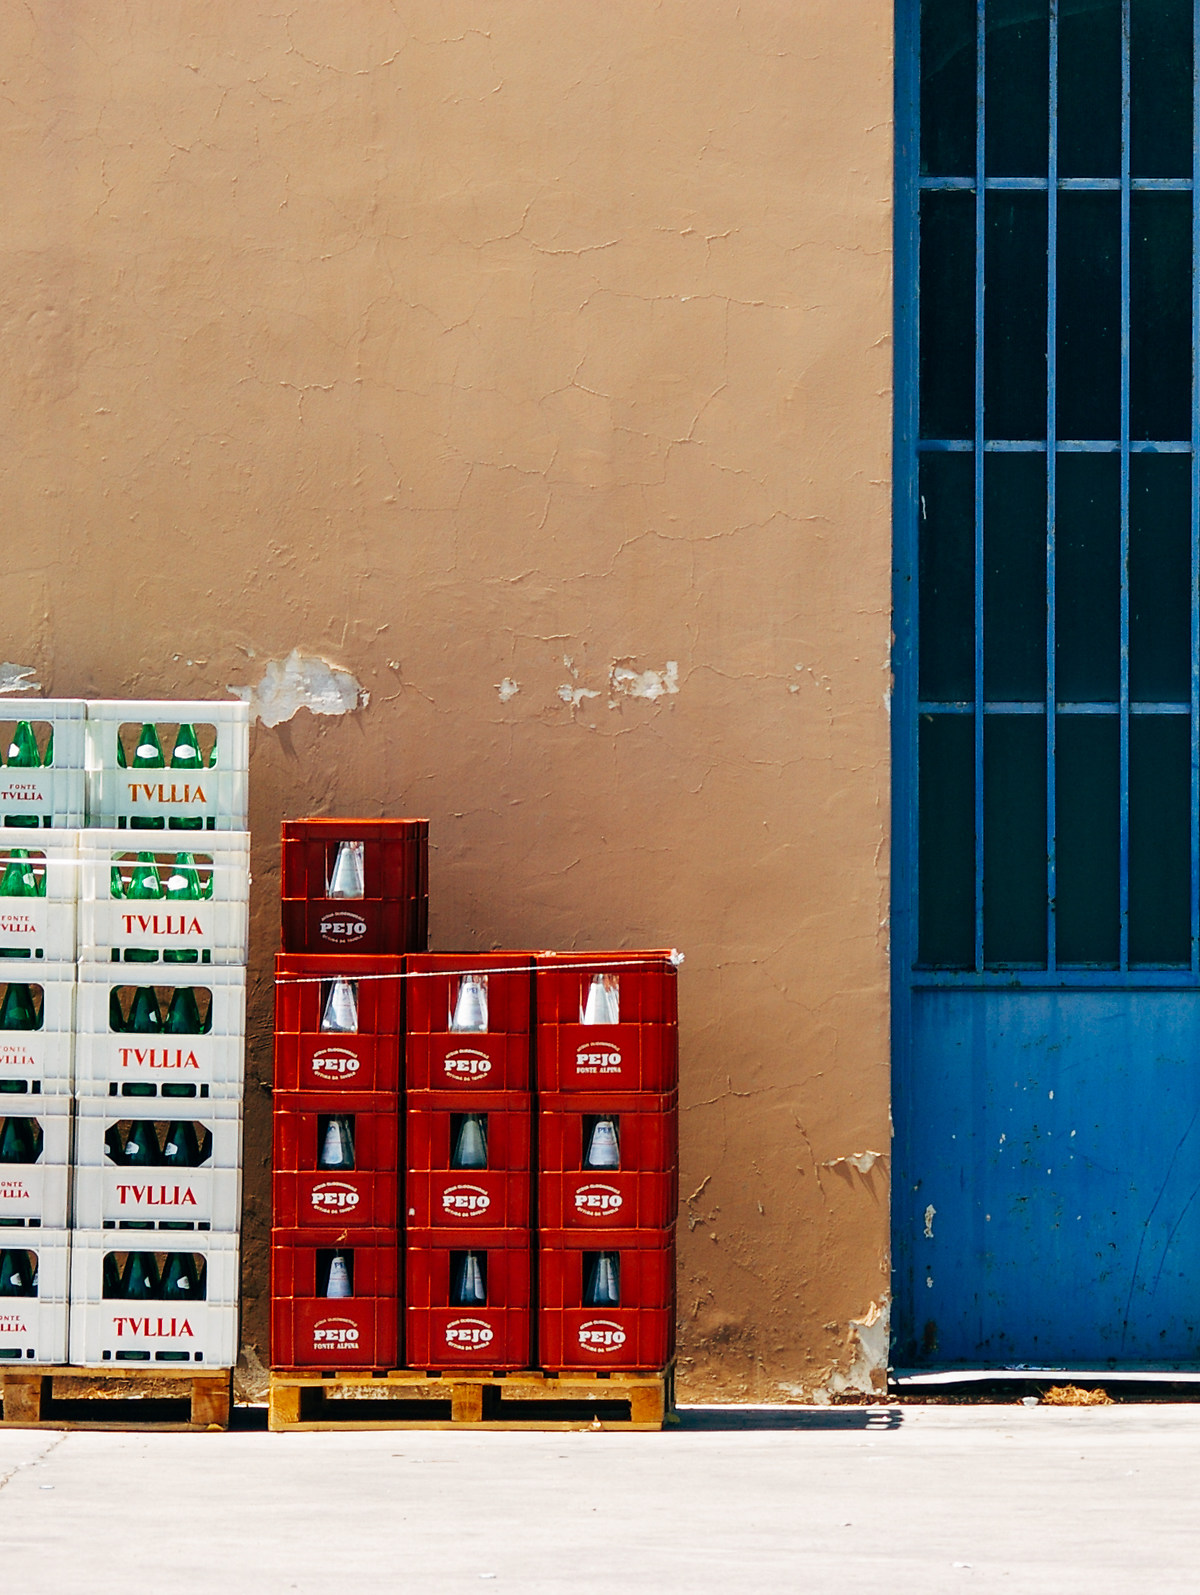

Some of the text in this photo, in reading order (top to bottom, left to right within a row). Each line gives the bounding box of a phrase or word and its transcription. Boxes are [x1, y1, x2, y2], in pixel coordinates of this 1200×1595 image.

[1, 791, 43, 800] TVLLIA
[128, 784, 206, 803] TVLLIA
[0, 923, 36, 932] VLLIA
[122, 915, 203, 935] TVLLIA
[321, 923, 366, 935] PEJO
[119, 1048, 199, 1069] TVLLIA
[577, 1053, 621, 1066] PEJO
[313, 1059, 359, 1072] PEJO
[444, 1060, 491, 1073] PEJO
[116, 1185, 196, 1205] TVLLIA
[312, 1193, 359, 1206] PEJO
[575, 1195, 622, 1208] PEJO
[443, 1196, 490, 1209] PEJO
[113, 1318, 194, 1337] TVLLIA
[314, 1329, 358, 1342] PEJO
[446, 1329, 493, 1342] PEJO
[579, 1331, 625, 1344] PEJO
